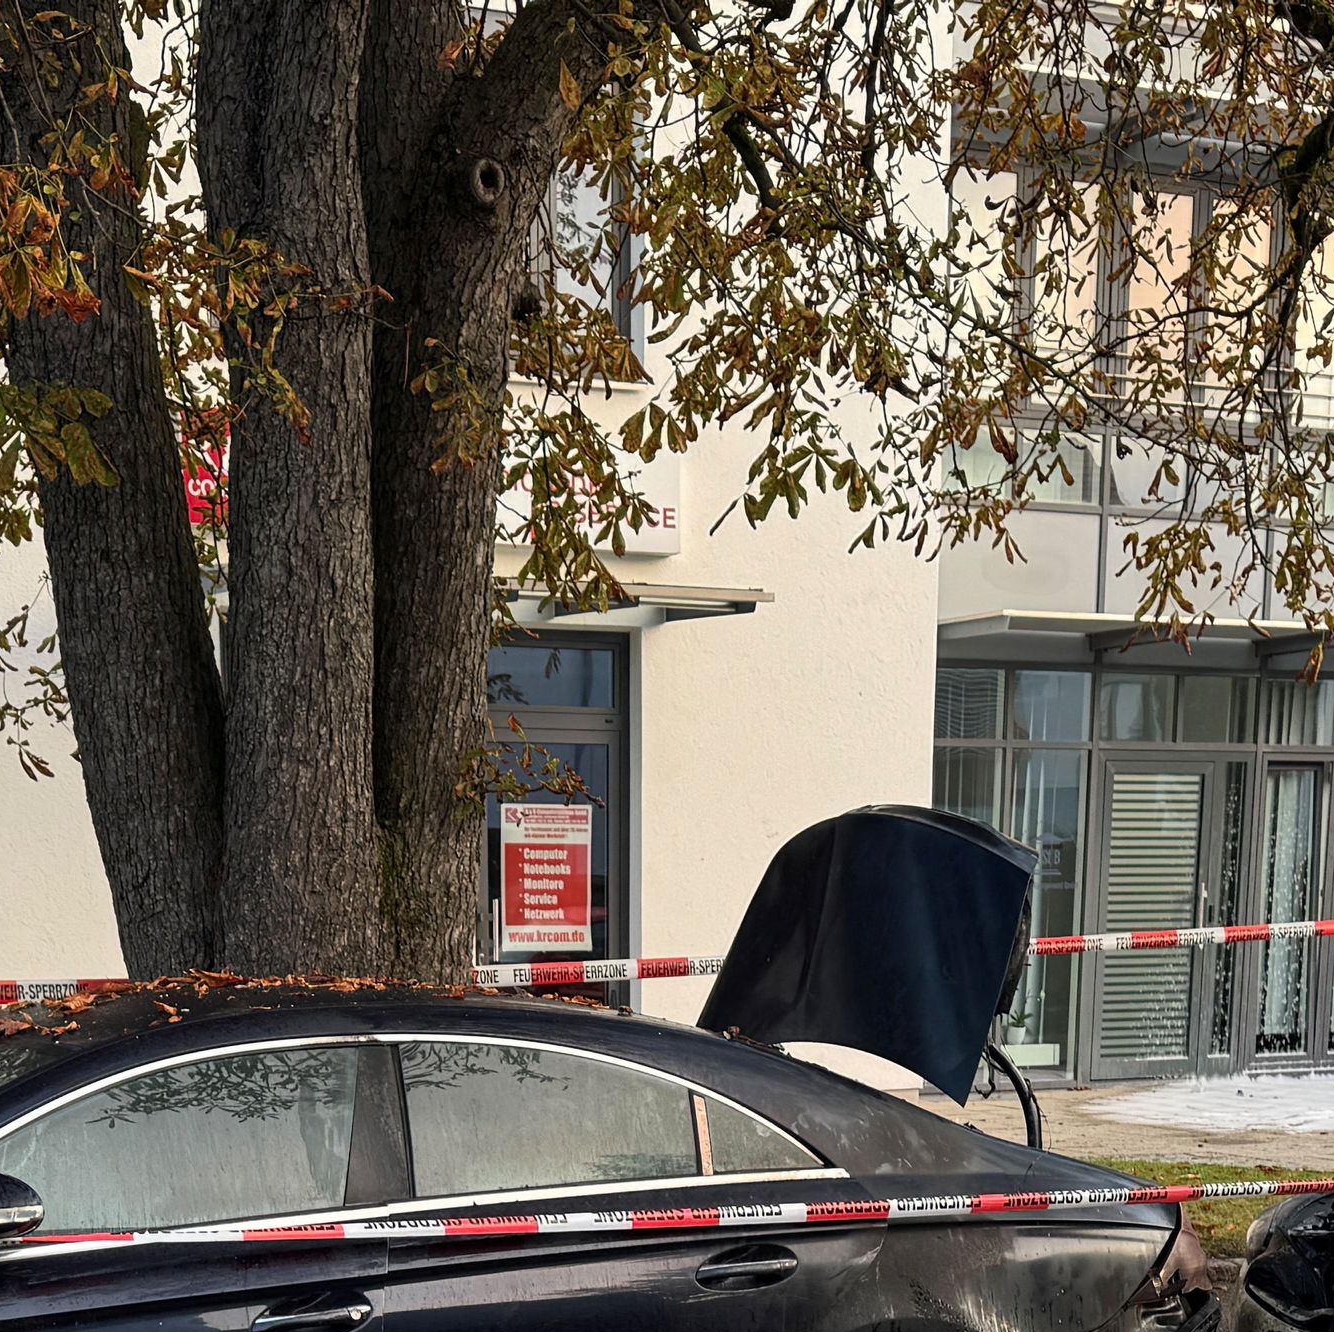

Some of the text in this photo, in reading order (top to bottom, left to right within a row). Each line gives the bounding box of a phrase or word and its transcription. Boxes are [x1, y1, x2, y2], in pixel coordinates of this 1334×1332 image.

[524, 848, 568, 860] Computer
[523, 863, 571, 875] Notebooks
[524, 878, 564, 890] Monitore
[524, 893, 558, 905] Service
[524, 908, 564, 920] Netzwerk
[508, 930, 585, 943] www.krcom.de
[513, 963, 628, 983] FEUERWEHR-SPERRZONE
